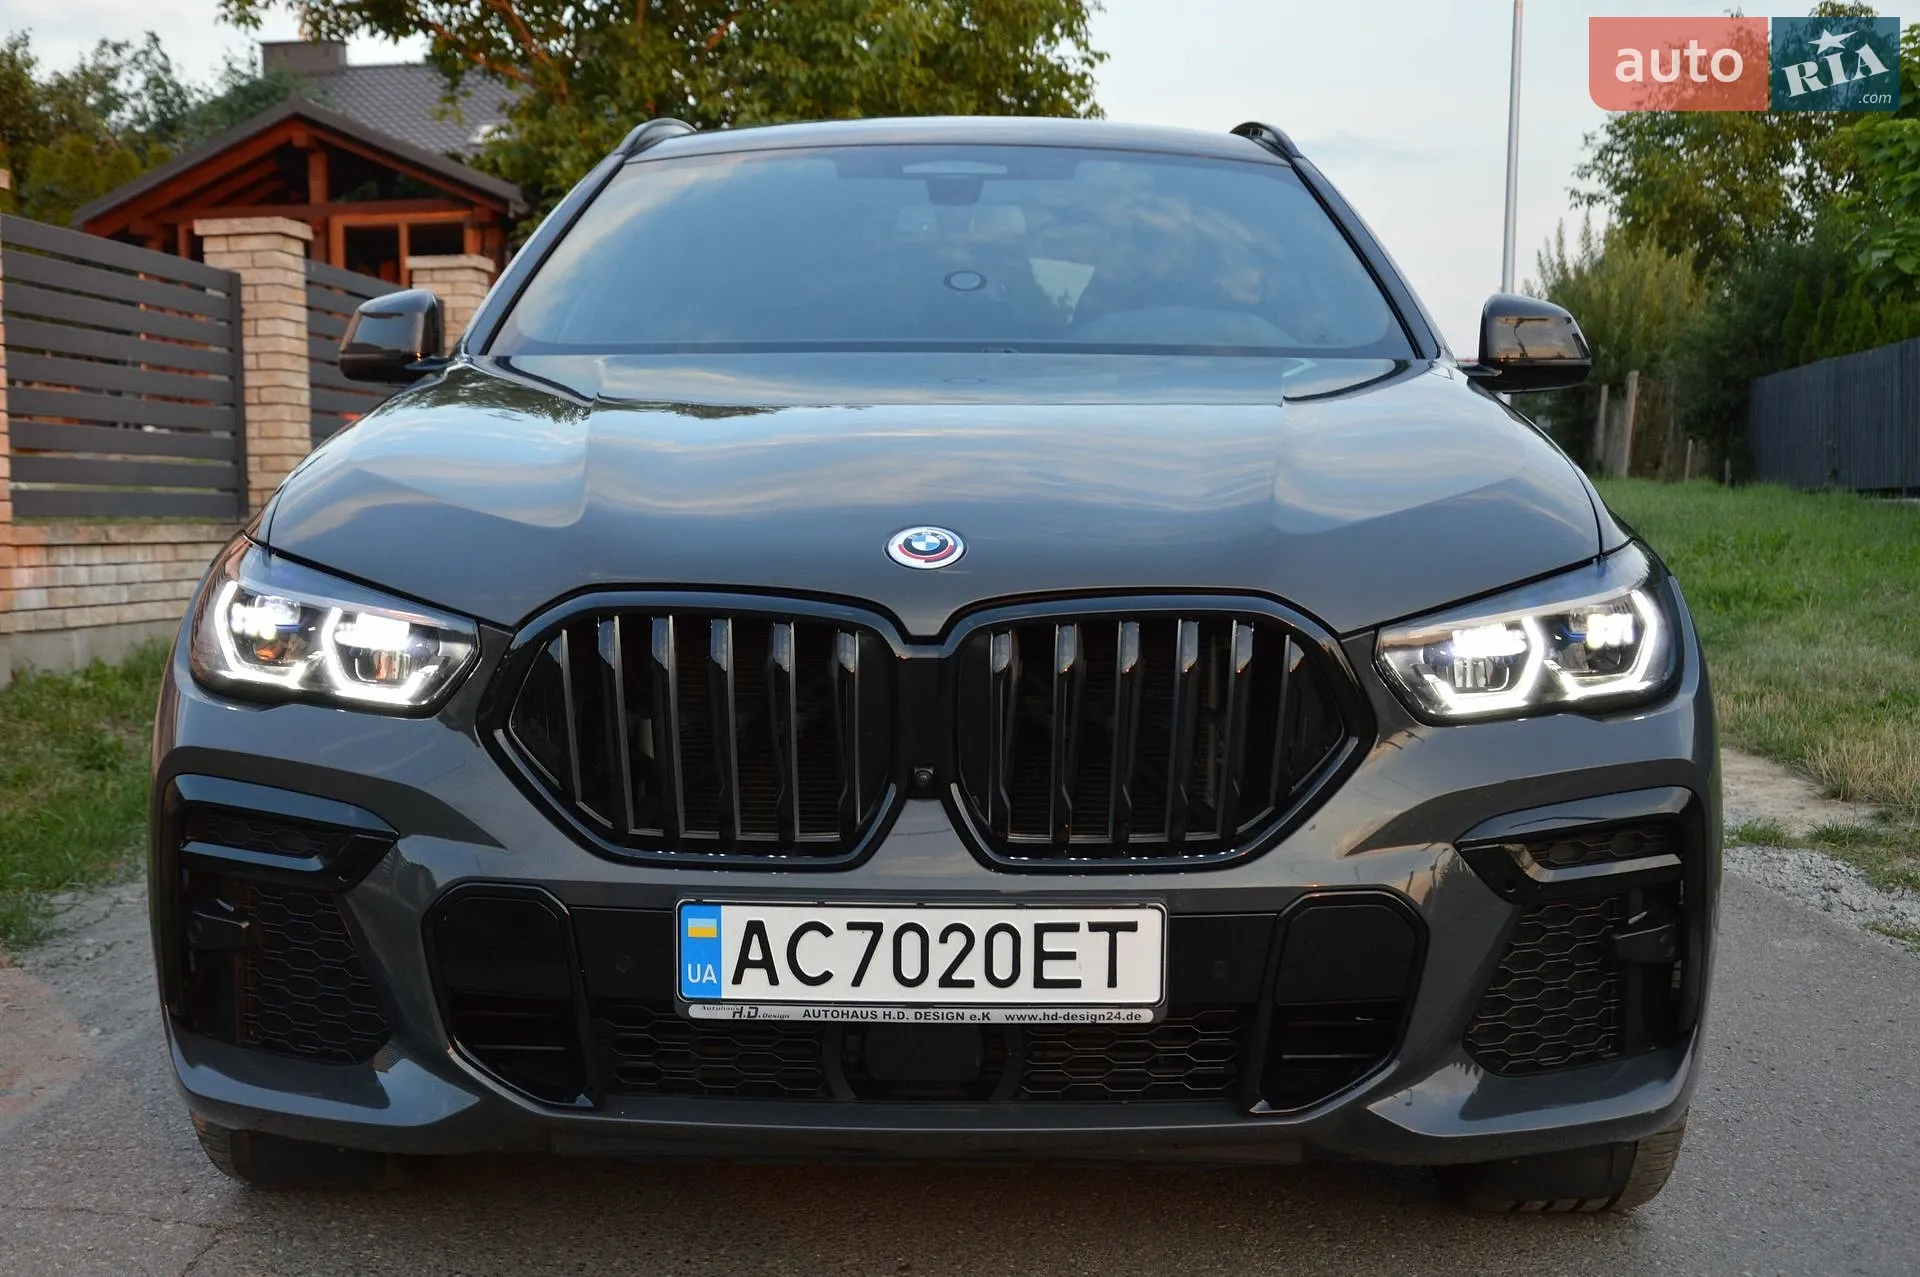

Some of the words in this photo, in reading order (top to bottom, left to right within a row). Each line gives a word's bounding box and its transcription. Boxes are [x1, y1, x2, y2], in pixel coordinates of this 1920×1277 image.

[731, 919, 1139, 989] AC7020ET
[688, 963, 717, 985] UA
[802, 1009, 878, 1019] AUTOHAUS
[882, 1010, 909, 1020] H.D.
[914, 1011, 965, 1021] DESIGN
[969, 1011, 991, 1021] e.K
[1004, 1011, 1142, 1023] www.hd-design24.de
